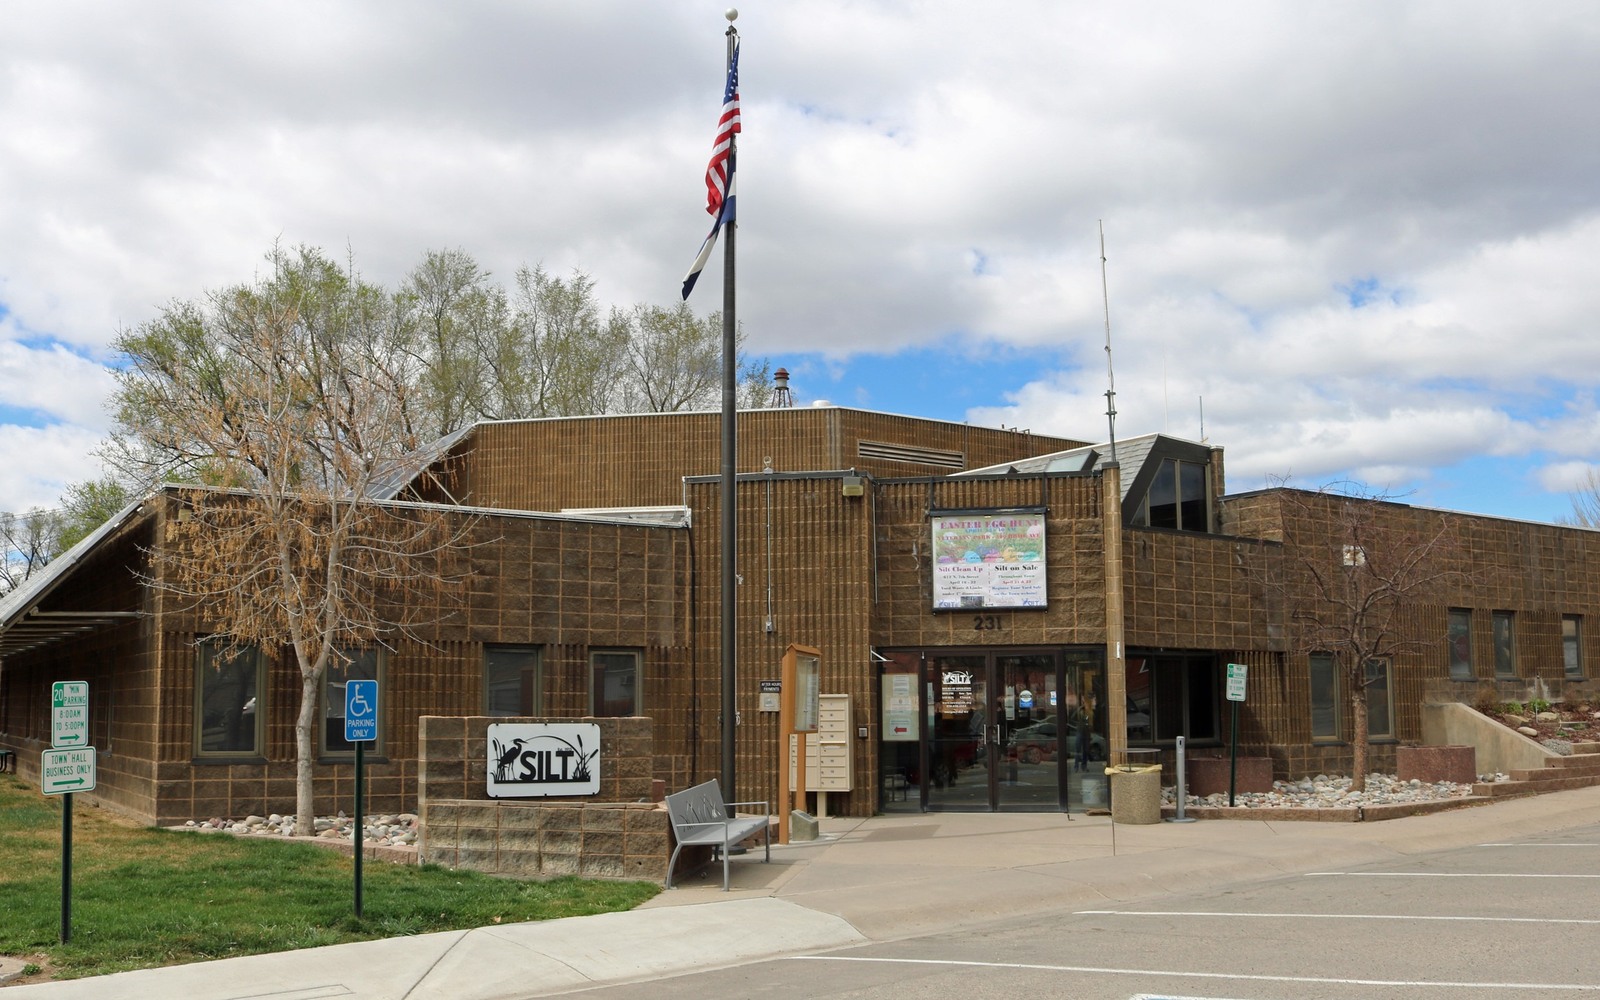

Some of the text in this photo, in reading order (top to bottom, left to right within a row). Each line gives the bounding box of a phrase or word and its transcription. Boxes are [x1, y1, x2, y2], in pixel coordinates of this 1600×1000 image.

[940, 519, 1039, 530] EASTER EGG HUNT
[974, 615, 1001, 630] 231
[950, 675, 966, 684] SILT
[55, 689, 63, 701] 20
[64, 696, 86, 704] PARKING
[60, 710, 81, 718] 8:00AM
[56, 721, 85, 730] TO 5:00PM
[348, 719, 374, 727] PARKING
[51, 753, 86, 764] TOWN HALL
[46, 764, 91, 777] BUSINESS ONLY
[519, 751, 574, 780] SILT
